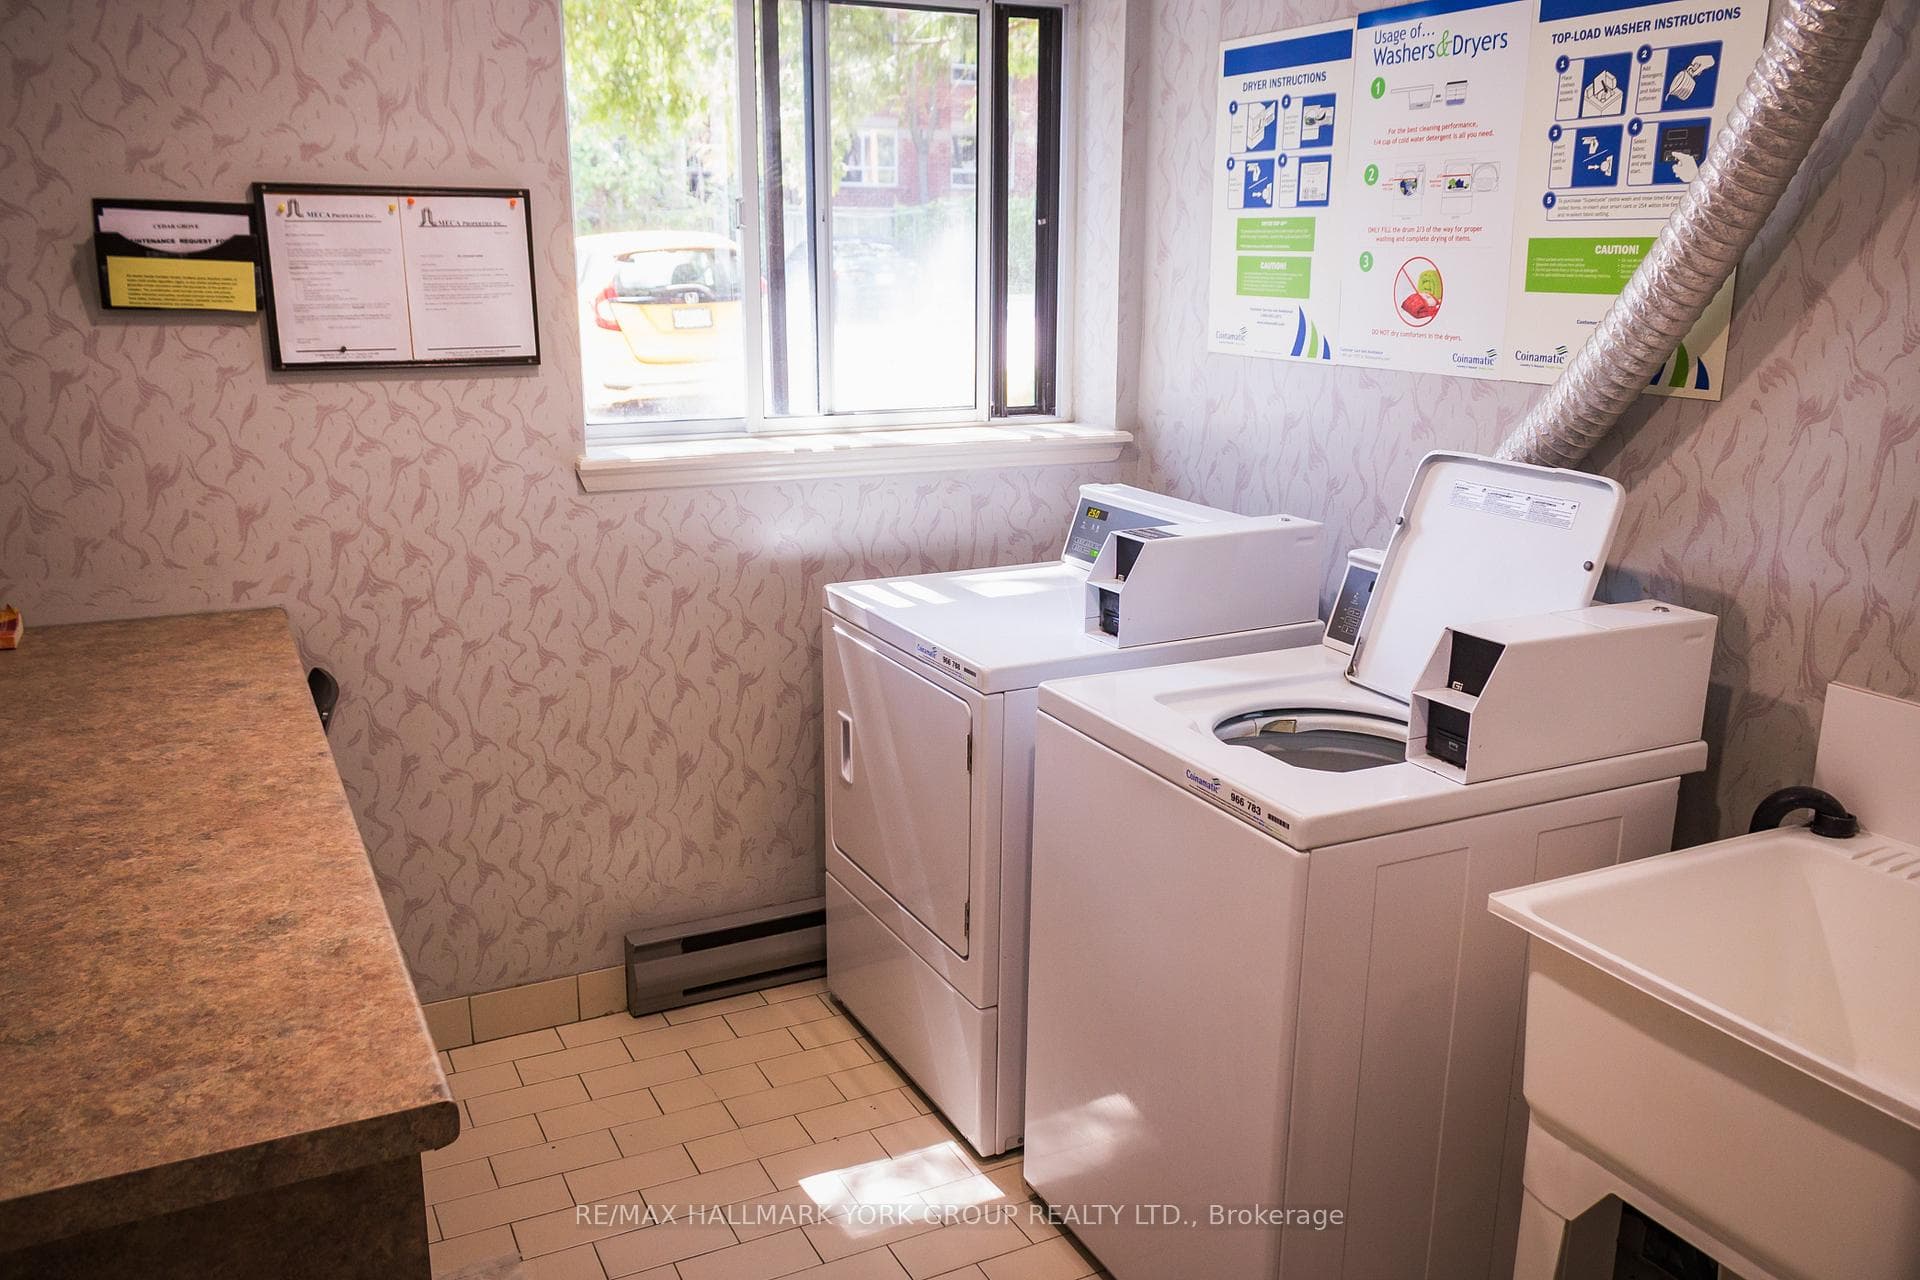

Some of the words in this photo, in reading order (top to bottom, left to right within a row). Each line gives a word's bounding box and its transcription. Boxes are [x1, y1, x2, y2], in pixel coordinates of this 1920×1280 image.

[1374, 28, 1407, 45] Usage
[1410, 22, 1435, 39] of...
[1551, 27, 1601, 45] TOP-LOAD
[1604, 20, 1651, 37] WASHER
[1654, 7, 1742, 30] INSTRUCTIONS
[1374, 43, 1436, 66] Washers
[1436, 29, 1453, 58] &
[1452, 32, 1508, 58] Dryers
[1242, 79, 1267, 92] DRYER
[1269, 71, 1327, 89] INSTRUCTIONS
[1426, 133, 1451, 142] detergent
[1467, 132, 1478, 140] you
[1368, 167, 1375, 182] 2
[306, 211, 331, 219] MECA
[1595, 244, 1640, 255] CAUTION!
[1362, 254, 1369, 269] 3
[1216, 330, 1246, 342] Coinamatic
[1452, 352, 1496, 366] Coinamatic
[1515, 350, 1566, 364] Coinamatic
[1185, 768, 1220, 794] Coinamatic
[1230, 792, 1245, 807] 966
[1246, 800, 1262, 816] 783
